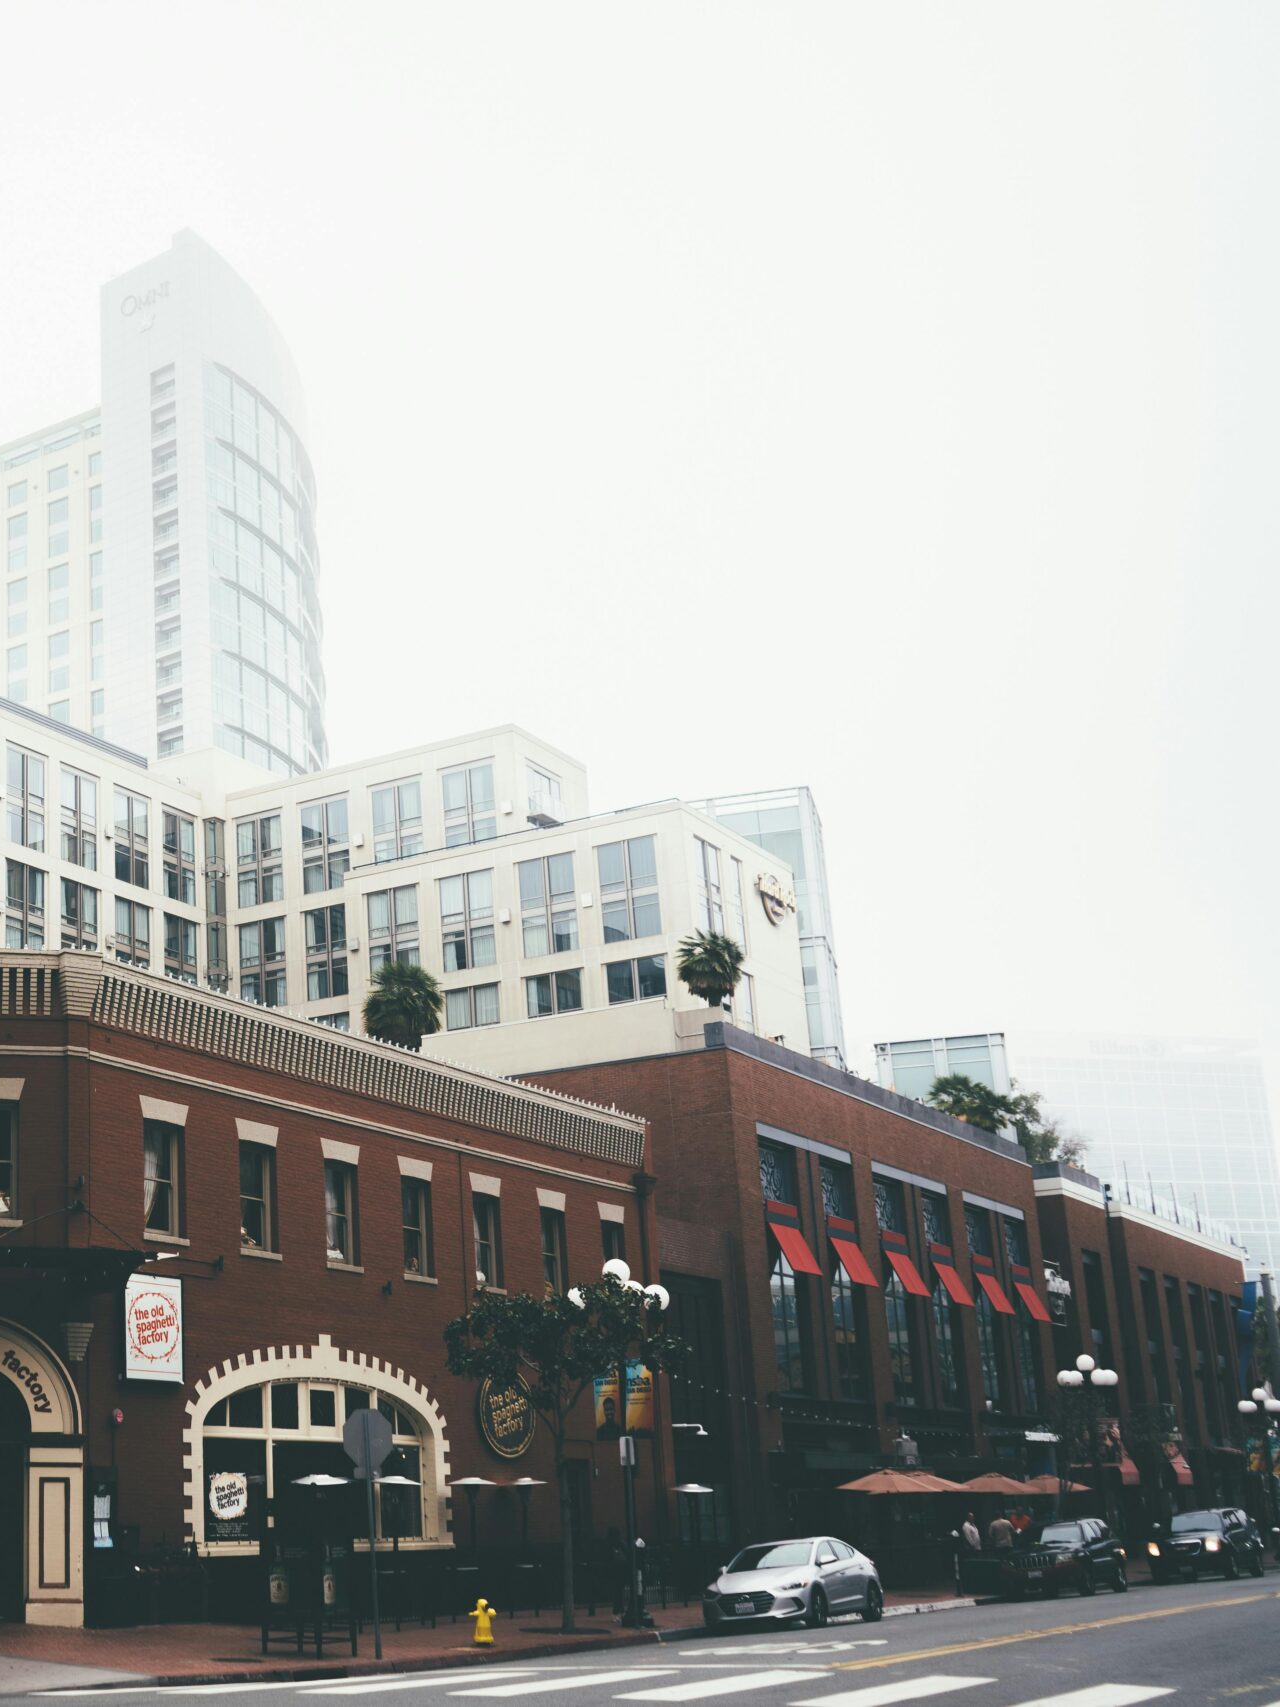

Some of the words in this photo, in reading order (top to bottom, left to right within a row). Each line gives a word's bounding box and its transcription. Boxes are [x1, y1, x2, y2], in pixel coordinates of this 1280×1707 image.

[134, 1308, 149, 1321] the
[151, 1305, 164, 1318] old
[136, 1314, 175, 1334] spaghetti
[138, 1330, 169, 1345] factory
[2, 1350, 52, 1414] factory
[489, 1394, 503, 1409] the
[494, 1416, 523, 1437] factory
[215, 1486, 225, 1494] the
[227, 1481, 236, 1491] old
[216, 1487, 245, 1501] spaghetti
[217, 1498, 240, 1510] factory
